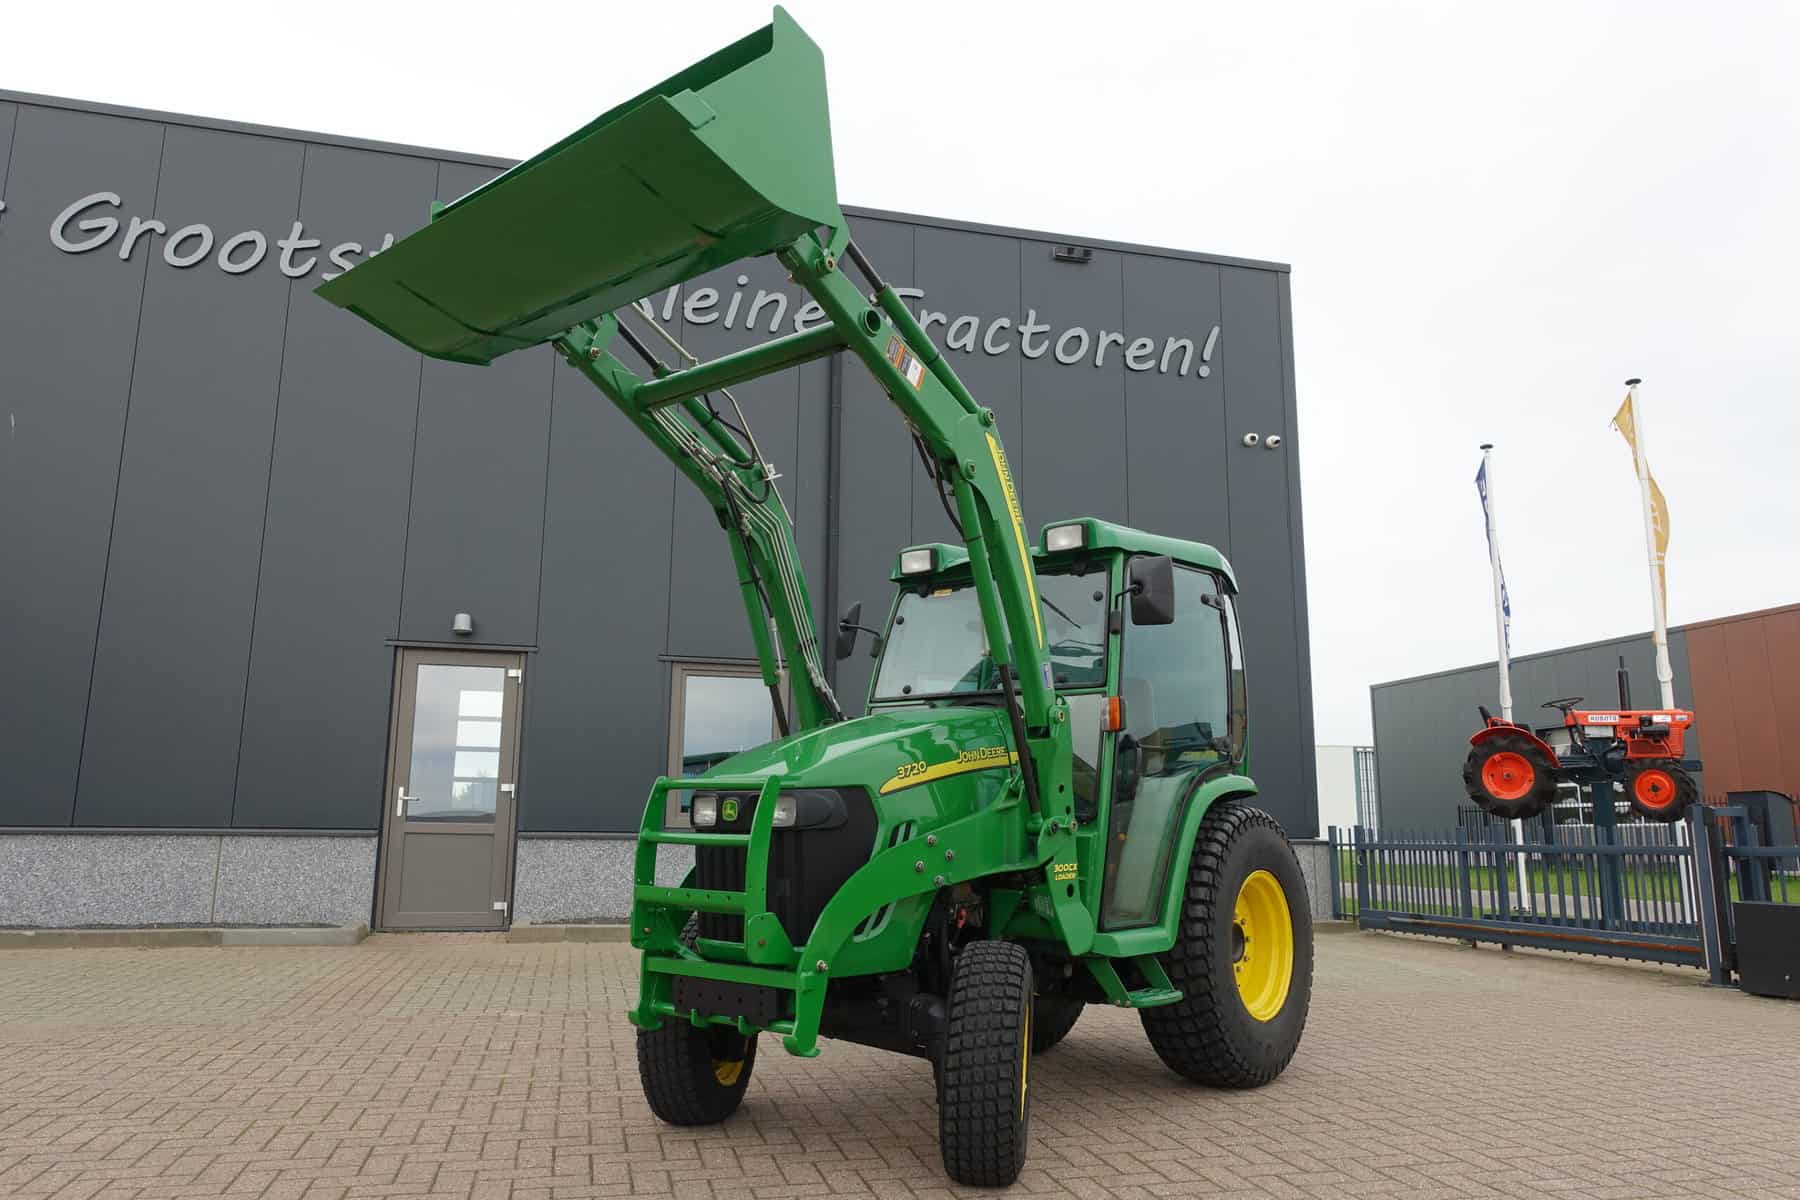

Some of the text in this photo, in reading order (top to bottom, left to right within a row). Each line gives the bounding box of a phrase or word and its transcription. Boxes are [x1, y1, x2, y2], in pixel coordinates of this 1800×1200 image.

[639, 274, 832, 333] leine
[958, 746, 1006, 763] JOHN DEERE
[896, 760, 928, 779] 3720
